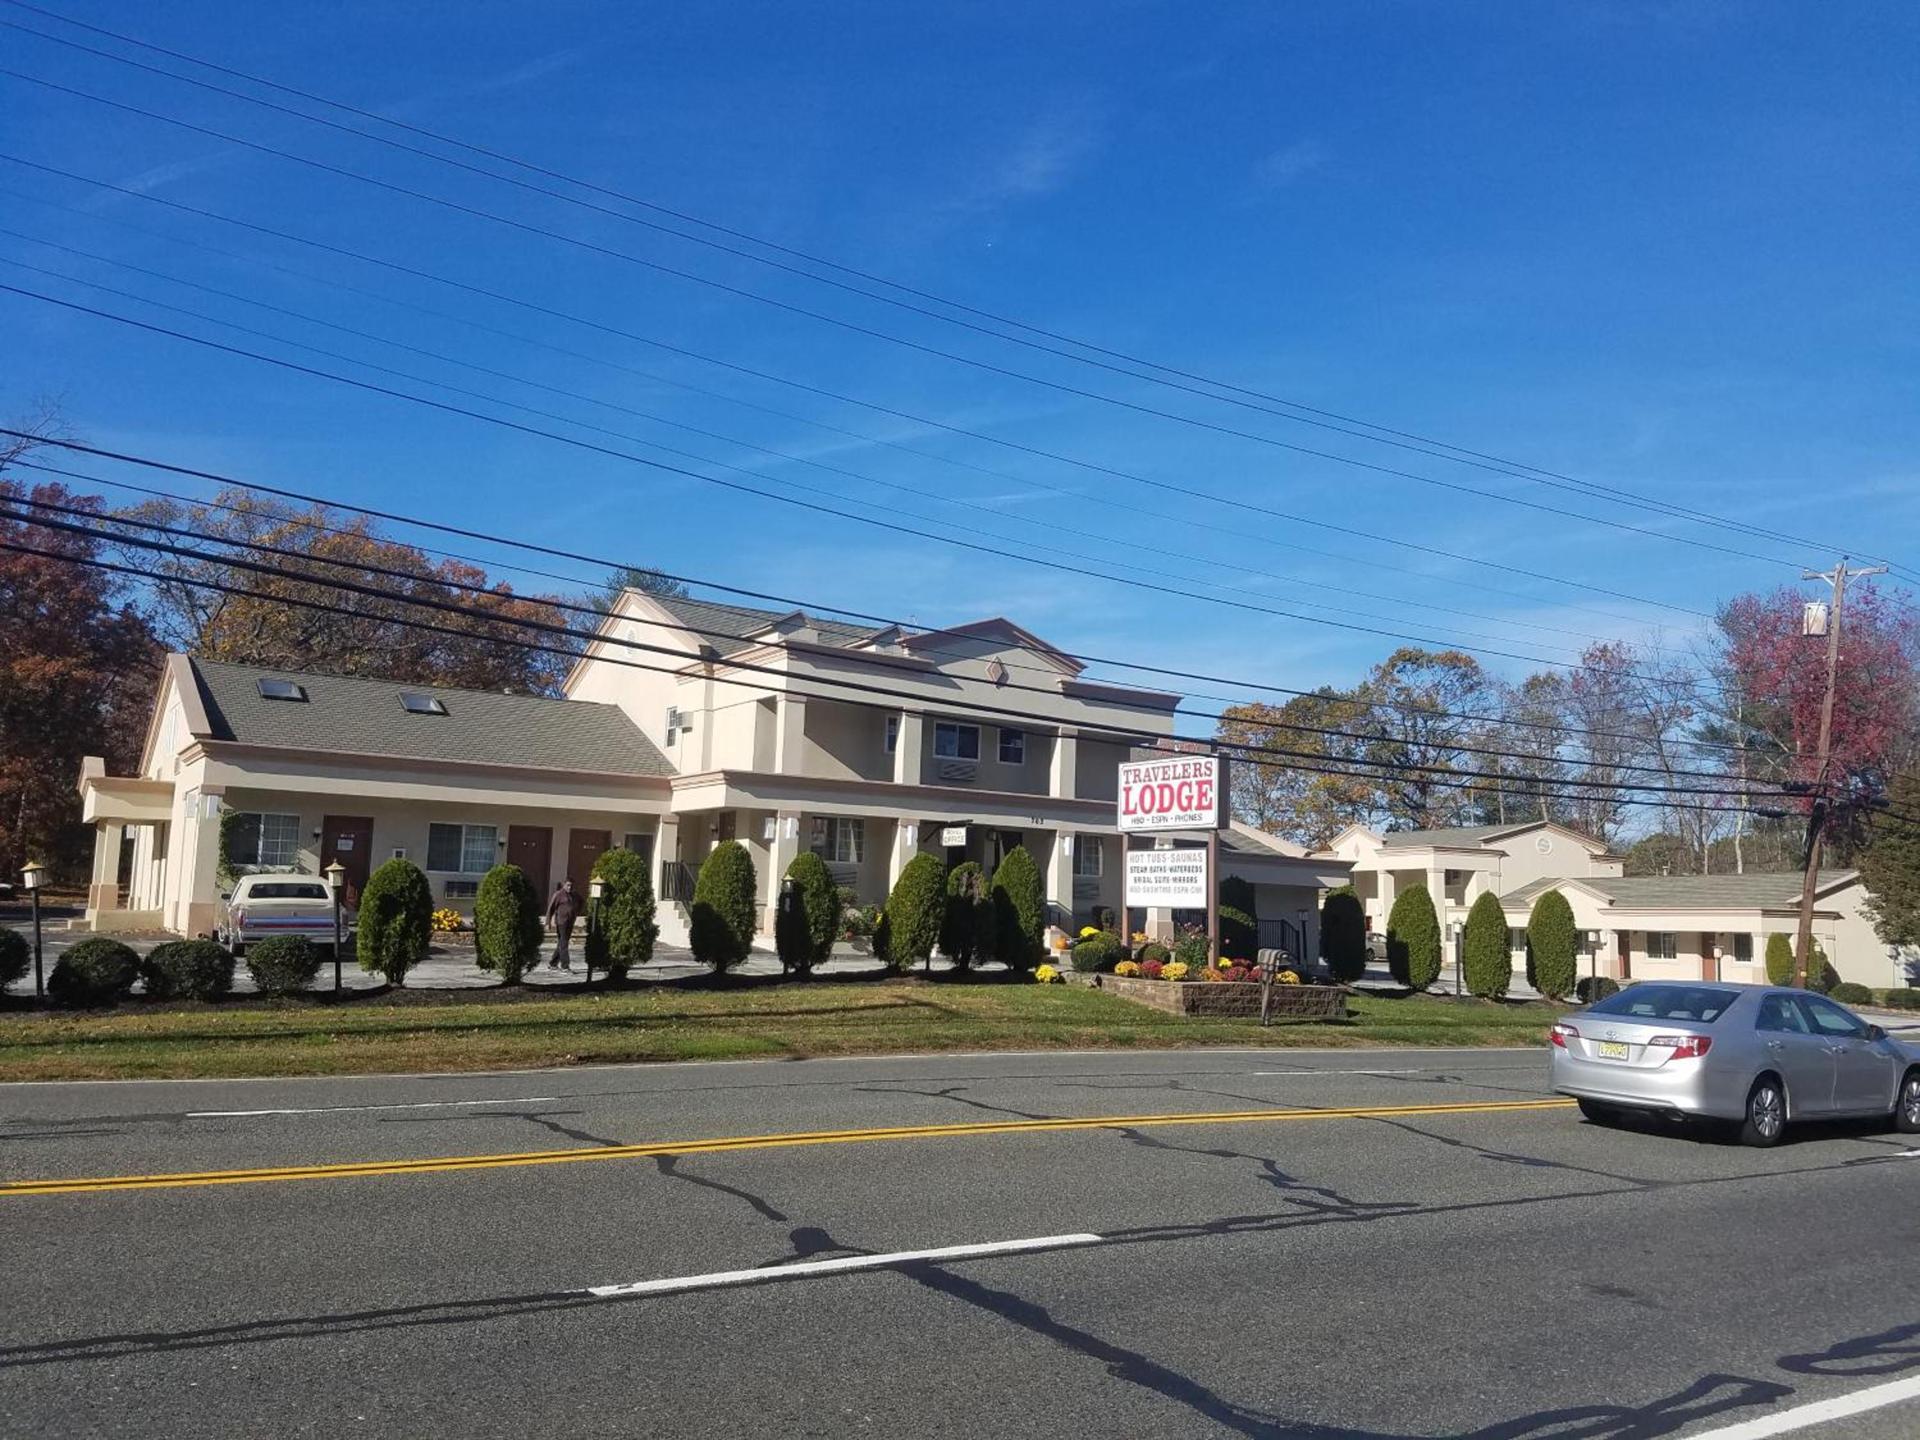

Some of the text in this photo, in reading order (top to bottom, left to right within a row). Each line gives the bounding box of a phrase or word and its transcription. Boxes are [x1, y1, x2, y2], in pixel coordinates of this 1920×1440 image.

[1123, 761, 1213, 785] TRAVELERS
[1122, 780, 1213, 815] LODGE
[1131, 813, 1203, 825] HBO ESPN PHONES
[1130, 854, 1145, 863] HOT
[1130, 866, 1148, 874] STEAM
